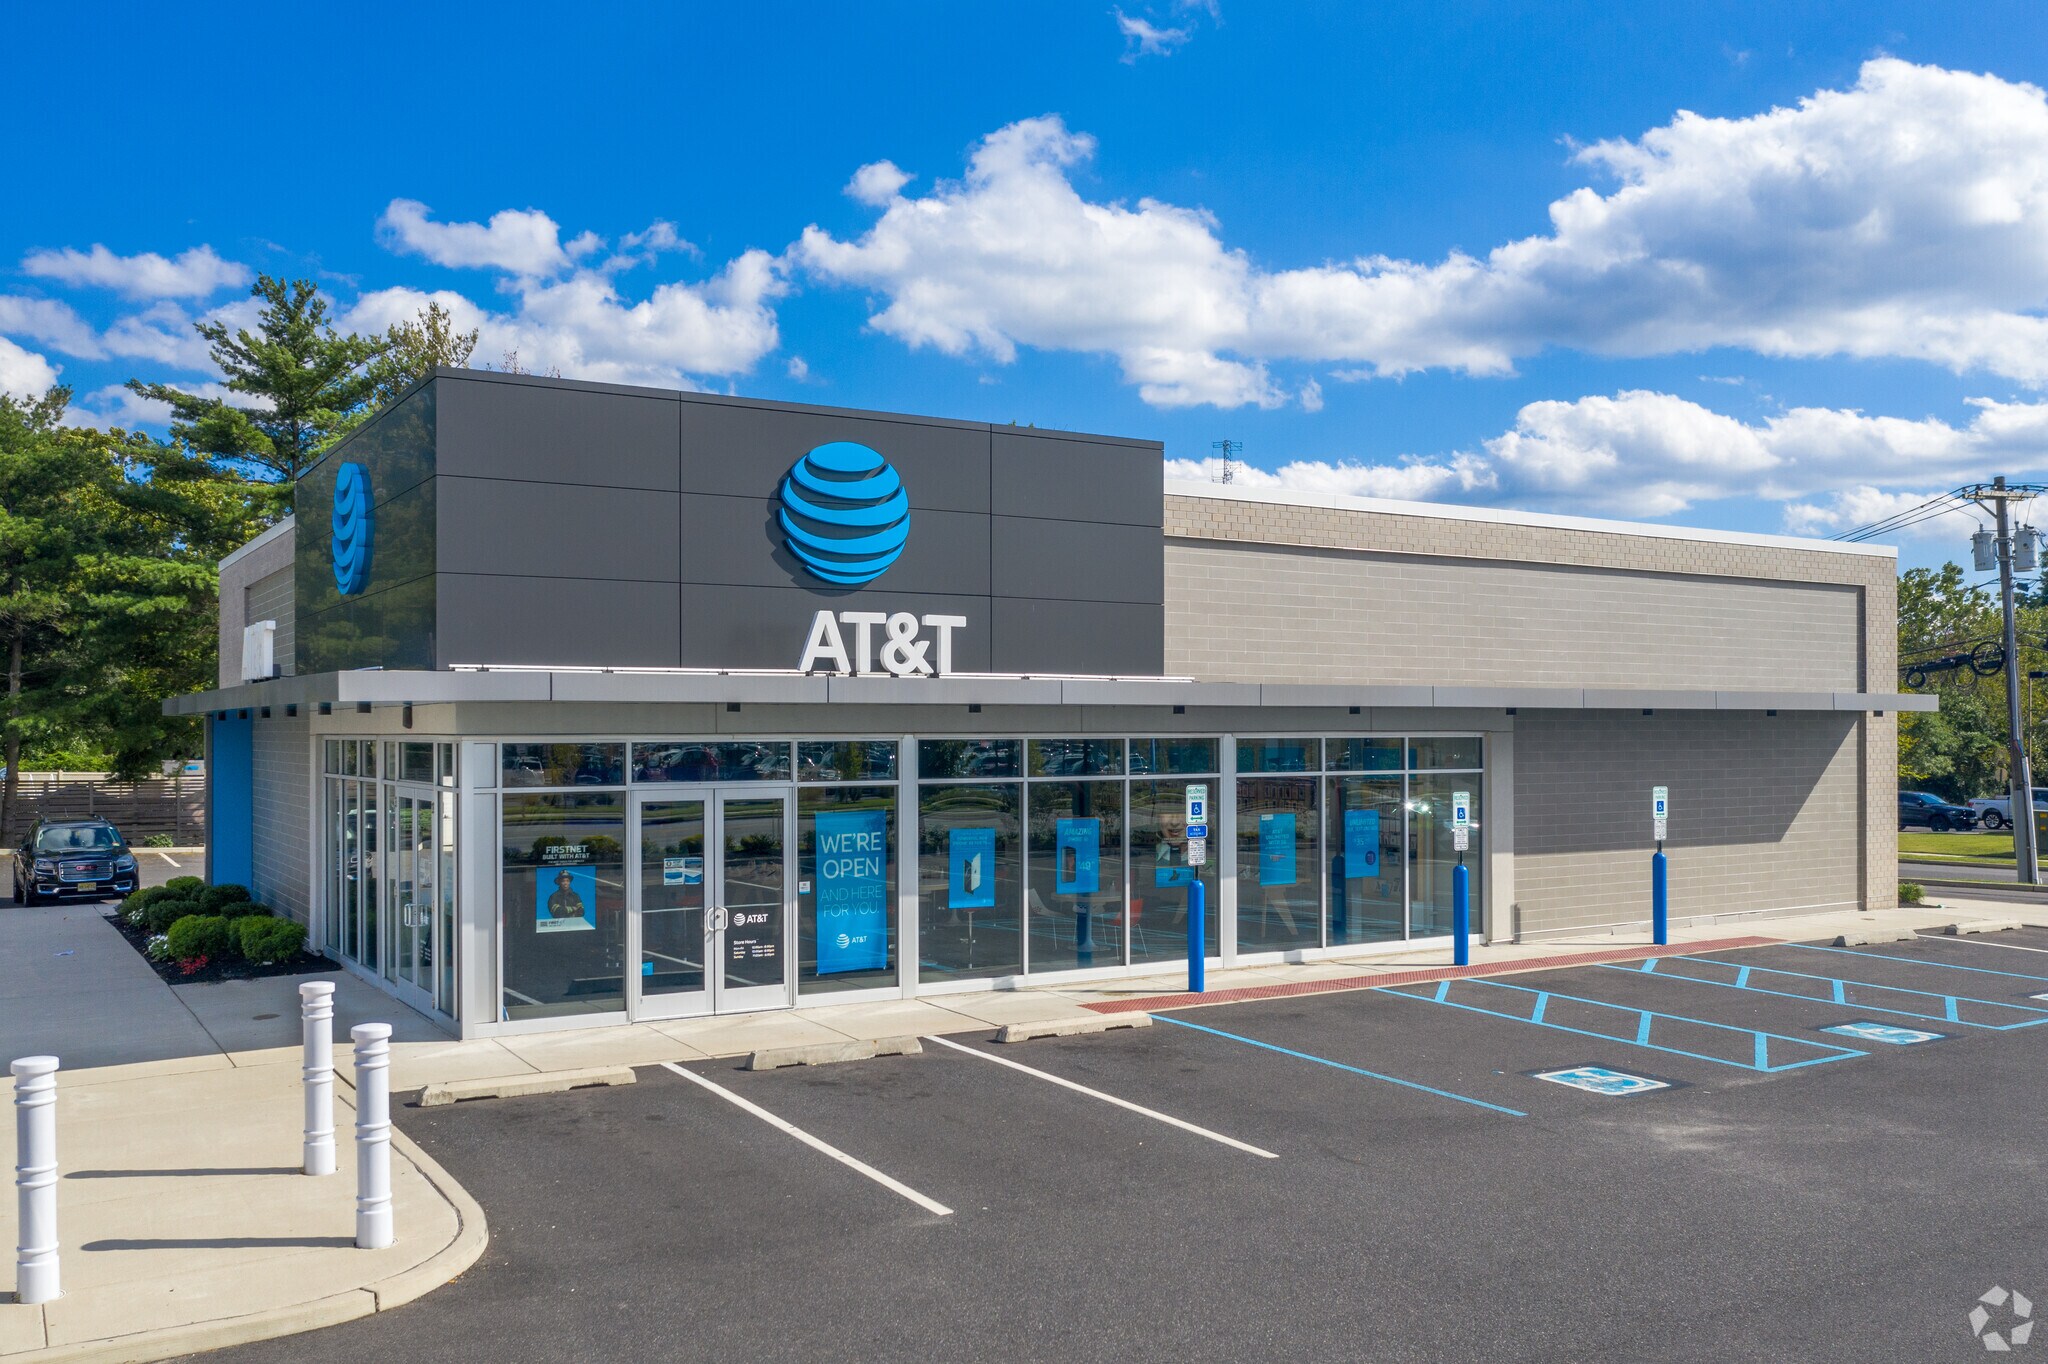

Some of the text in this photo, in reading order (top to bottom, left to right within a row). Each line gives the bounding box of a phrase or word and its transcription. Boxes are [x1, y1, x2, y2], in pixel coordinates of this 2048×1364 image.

[797, 610, 967, 674] AT&T
[546, 845, 589, 854] FIRSTNET
[820, 832, 882, 854] WE'RE
[823, 857, 879, 879] OPEN
[820, 884, 882, 902] AND HERE
[823, 901, 880, 918] FOR YOU.
[746, 914, 768, 923] AT&T
[851, 935, 867, 943] AT&T
